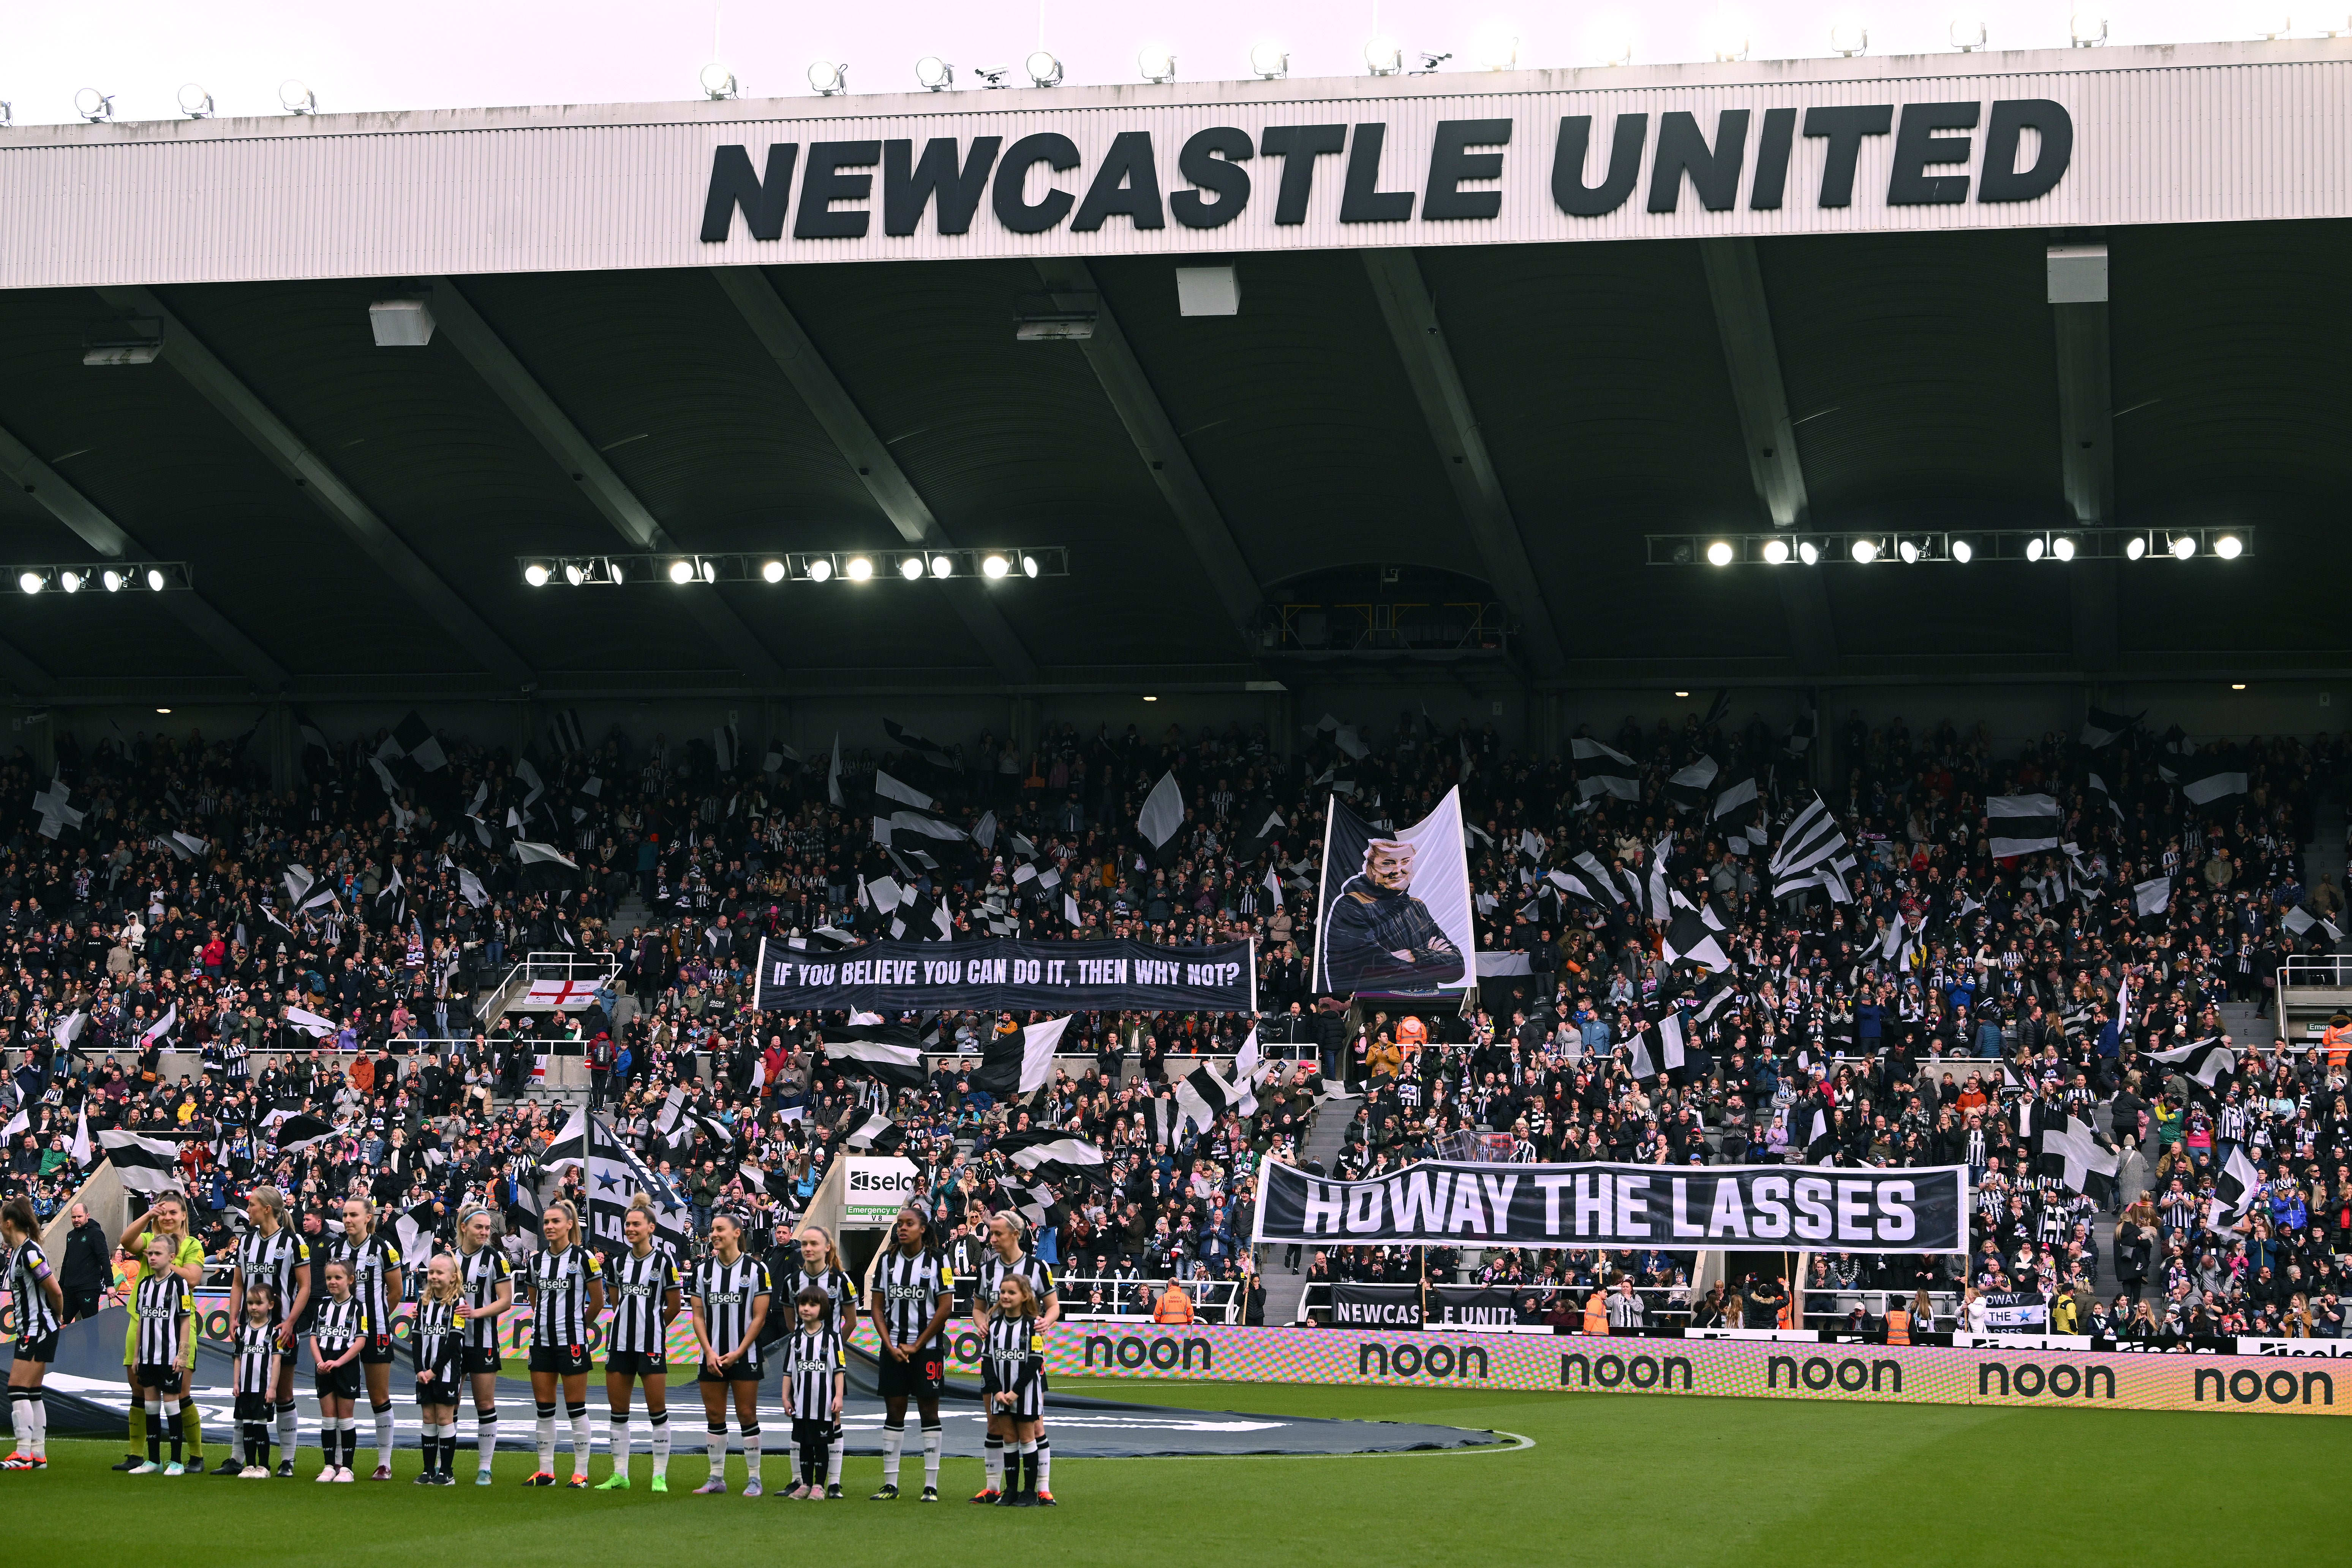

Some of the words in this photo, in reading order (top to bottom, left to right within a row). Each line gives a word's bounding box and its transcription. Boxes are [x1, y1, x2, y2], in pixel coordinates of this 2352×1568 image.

[701, 119, 1513, 242] NEWCASTLE
[1552, 100, 2073, 217] UNITED
[773, 963, 793, 985] IF
[799, 963, 836, 986] YOU
[842, 960, 917, 985] BELIEVE
[924, 961, 965, 985] YOU
[967, 959, 1006, 984] CAN
[1014, 959, 1045, 985] DO
[1047, 960, 1070, 987] IT,
[1078, 959, 1127, 984] THEN
[1135, 959, 1180, 985] WHY
[1187, 962, 1240, 986] NOT?
[1303, 1171, 1519, 1234] HOWAY
[1535, 1174, 1651, 1236] THE
[1673, 1176, 1915, 1241] LASSES
[254, 1263, 275, 1274] sela
[355, 1270, 367, 1281] la
[547, 1278, 569, 1289] sela
[629, 1284, 651, 1296] sela
[718, 1292, 741, 1303] sela
[897, 1285, 926, 1299] sela
[1986, 1294, 2020, 1305] OWAY
[149, 1307, 169, 1318] sela
[1338, 1302, 1454, 1324] NEWCASE
[1461, 1306, 1518, 1325] UNITE
[1989, 1311, 2011, 1322] THE
[327, 1326, 349, 1337] sela
[248, 1345, 265, 1354] sela
[1001, 1349, 1025, 1360] sela
[1085, 1336, 1211, 1370] noon
[803, 1360, 825, 1370] sela
[1359, 1344, 1488, 1378] noon
[926, 1361, 943, 1380] 90
[1561, 1353, 1692, 1389] noon
[1769, 1356, 1902, 1392] noon
[1979, 1363, 2115, 1399] noon
[2195, 1368, 2333, 1405] noon
